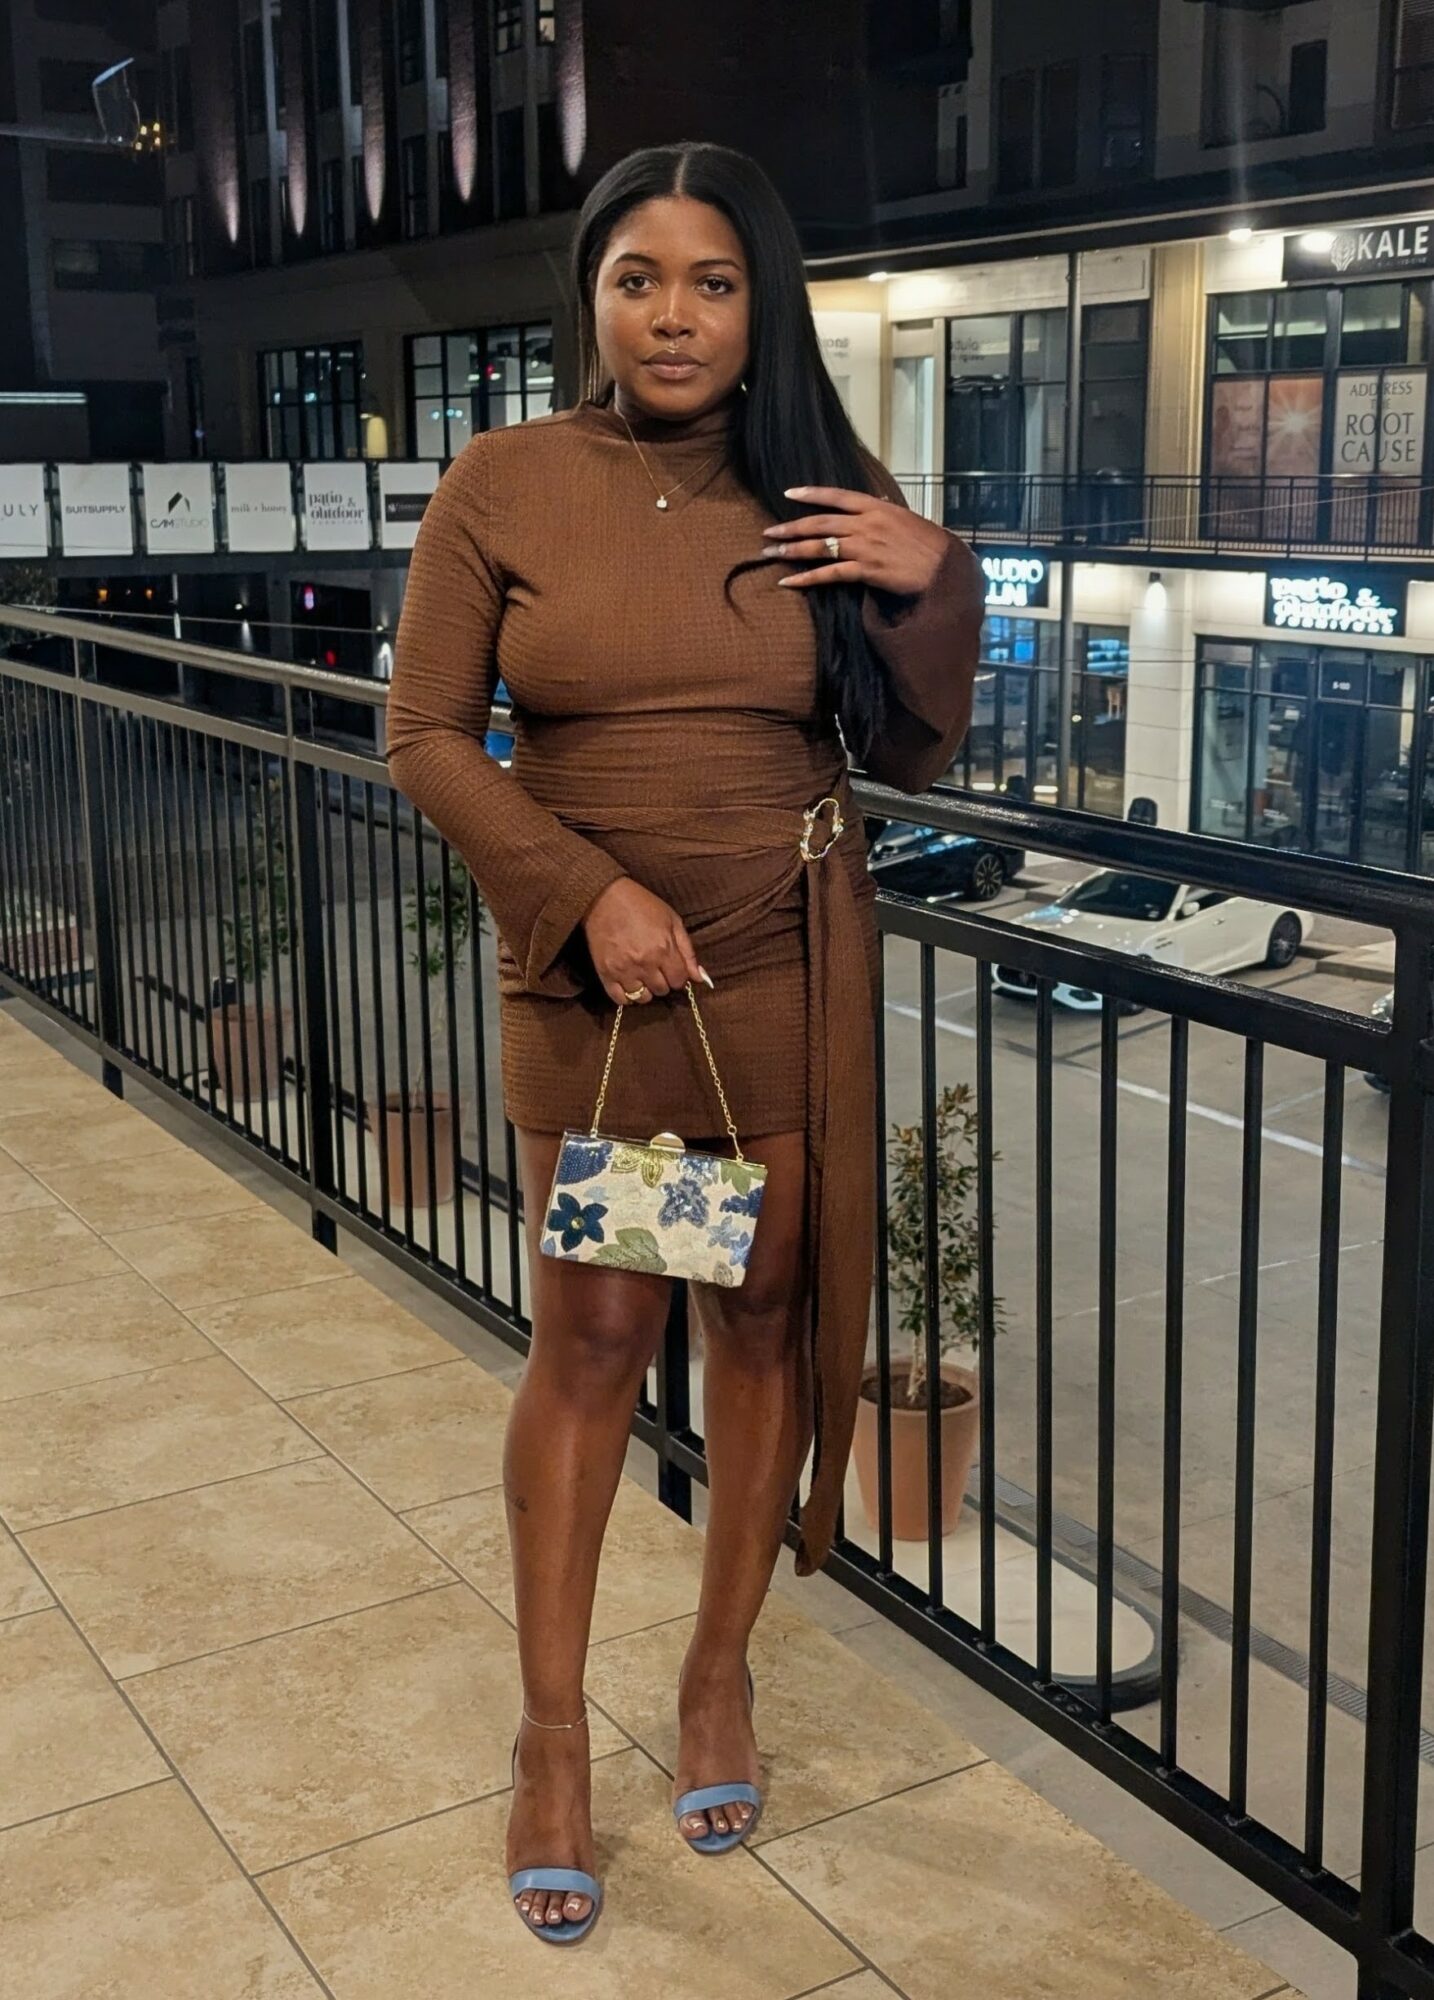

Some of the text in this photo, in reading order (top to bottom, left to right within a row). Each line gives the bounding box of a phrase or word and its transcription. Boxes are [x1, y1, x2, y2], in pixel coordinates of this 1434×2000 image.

[1357, 226, 1429, 260] KALE
[1350, 381, 1413, 396] ADDRESS
[1345, 412, 1414, 436] ROOT
[1341, 440, 1416, 463] CAUSE
[309, 490, 343, 506] patio
[65, 504, 126, 514] SUITSUPPLY
[231, 503, 250, 513] milk
[261, 502, 287, 514] honey
[311, 505, 365, 519] outdoor
